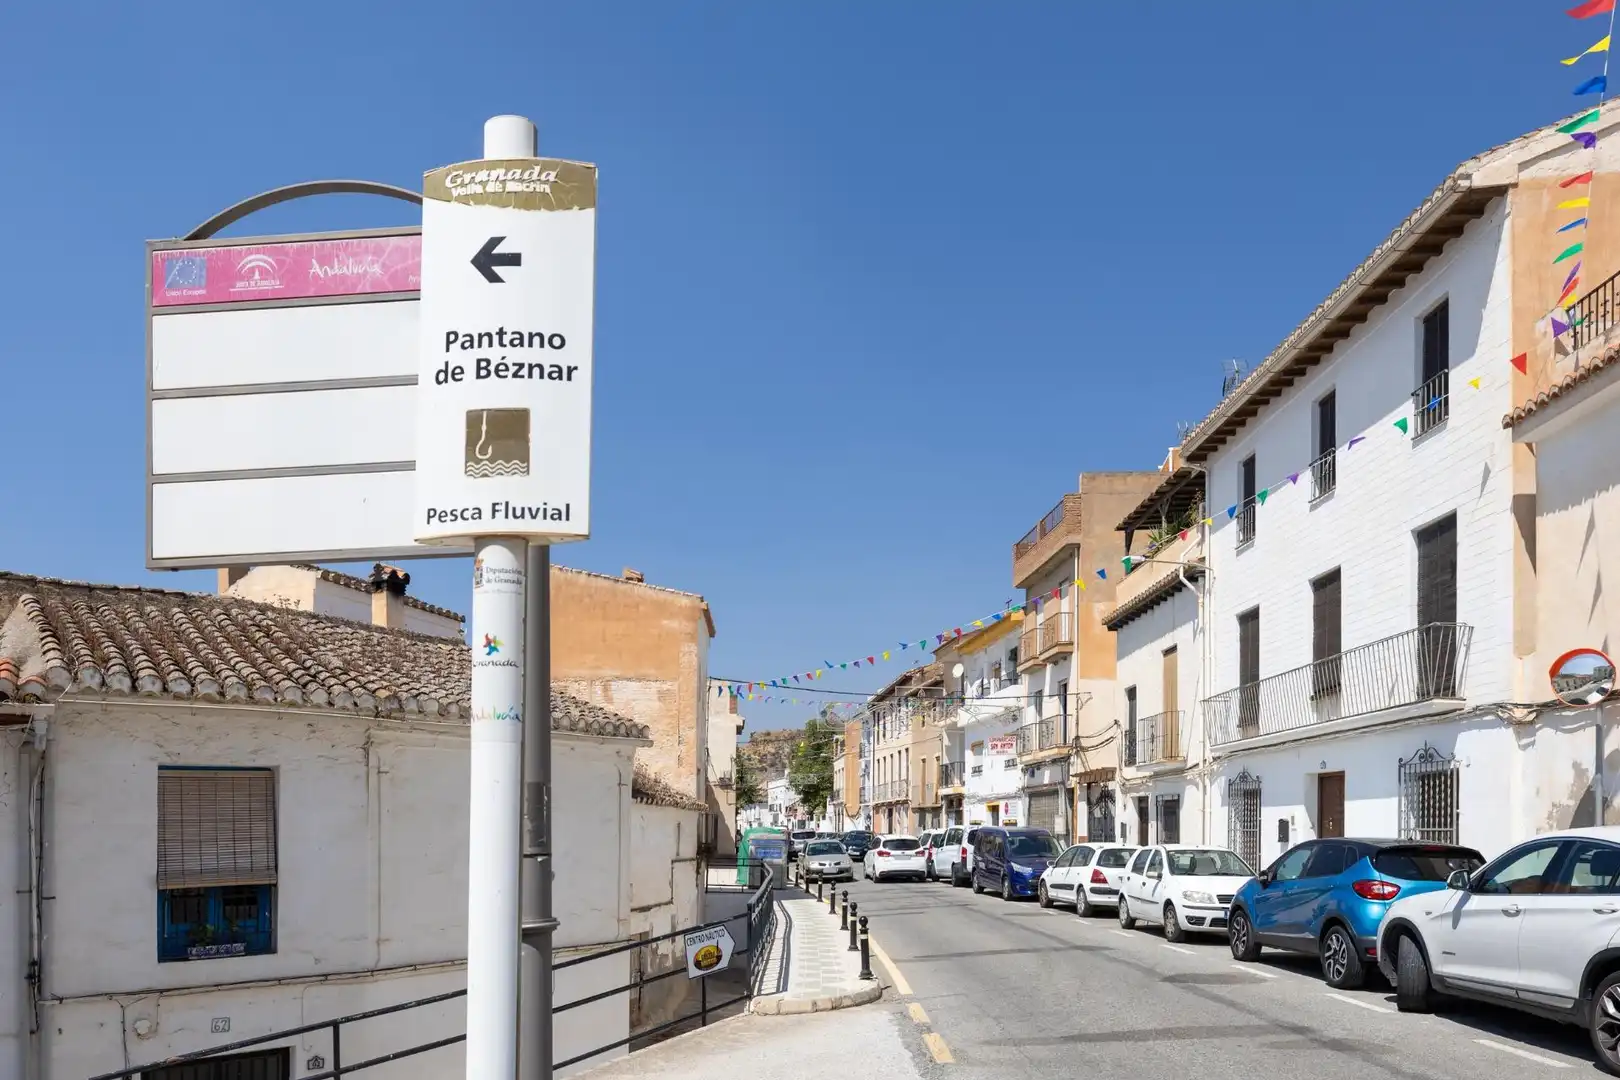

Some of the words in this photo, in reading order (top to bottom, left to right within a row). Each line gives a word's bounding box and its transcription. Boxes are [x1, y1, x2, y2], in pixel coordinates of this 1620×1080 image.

[445, 164, 559, 188] Granada
[445, 326, 567, 353] Pantano
[435, 361, 465, 386] de
[475, 356, 578, 382] Béznar
[426, 506, 482, 525] Pesca
[491, 501, 571, 522] Fluvial
[486, 566, 523, 576] Diputación
[486, 576, 493, 584] de
[494, 576, 523, 585] Granada
[687, 934, 705, 946] CENTRO
[214, 1019, 228, 1032] 62
